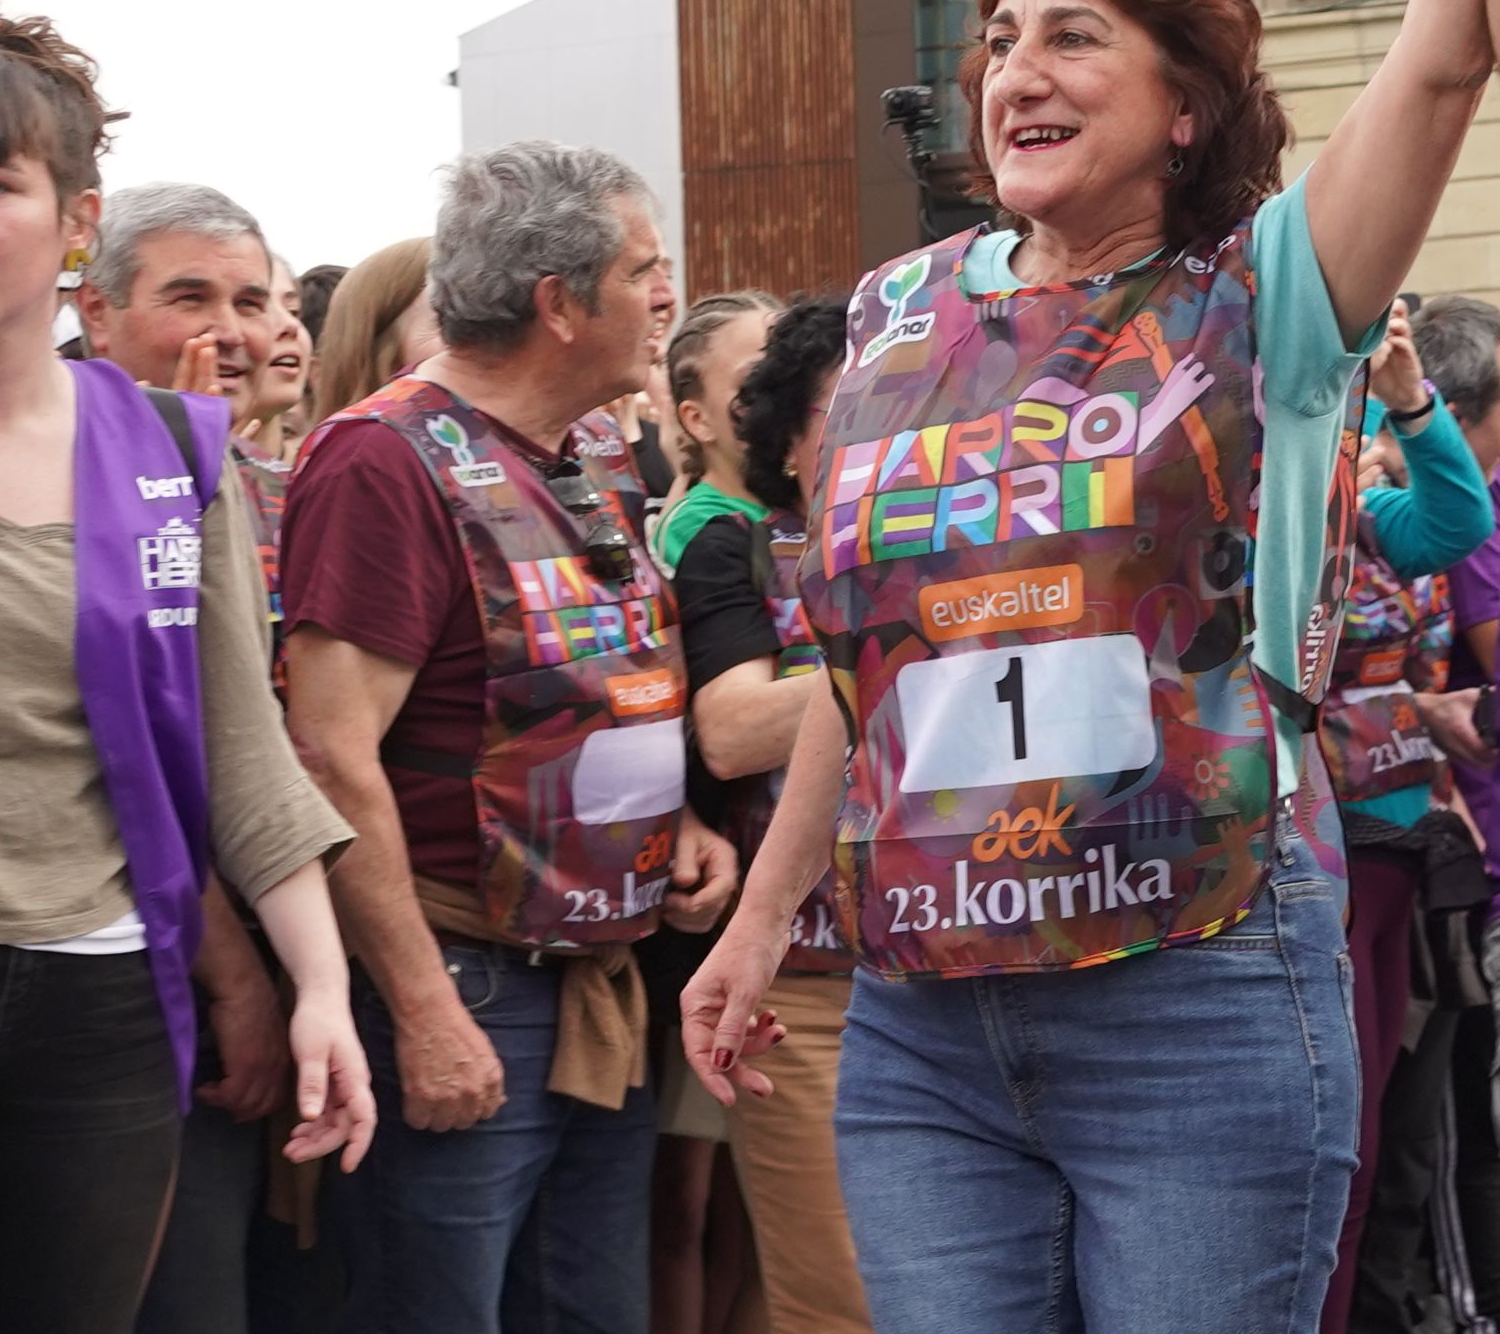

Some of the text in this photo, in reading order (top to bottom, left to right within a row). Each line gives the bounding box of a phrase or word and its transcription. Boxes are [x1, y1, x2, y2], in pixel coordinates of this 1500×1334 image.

[828, 391, 1140, 507] HARRO
[930, 575, 1071, 628] euskaltel
[994, 656, 1028, 761] 1
[972, 781, 1077, 864] aek
[884, 843, 1176, 935] 23.korrika
